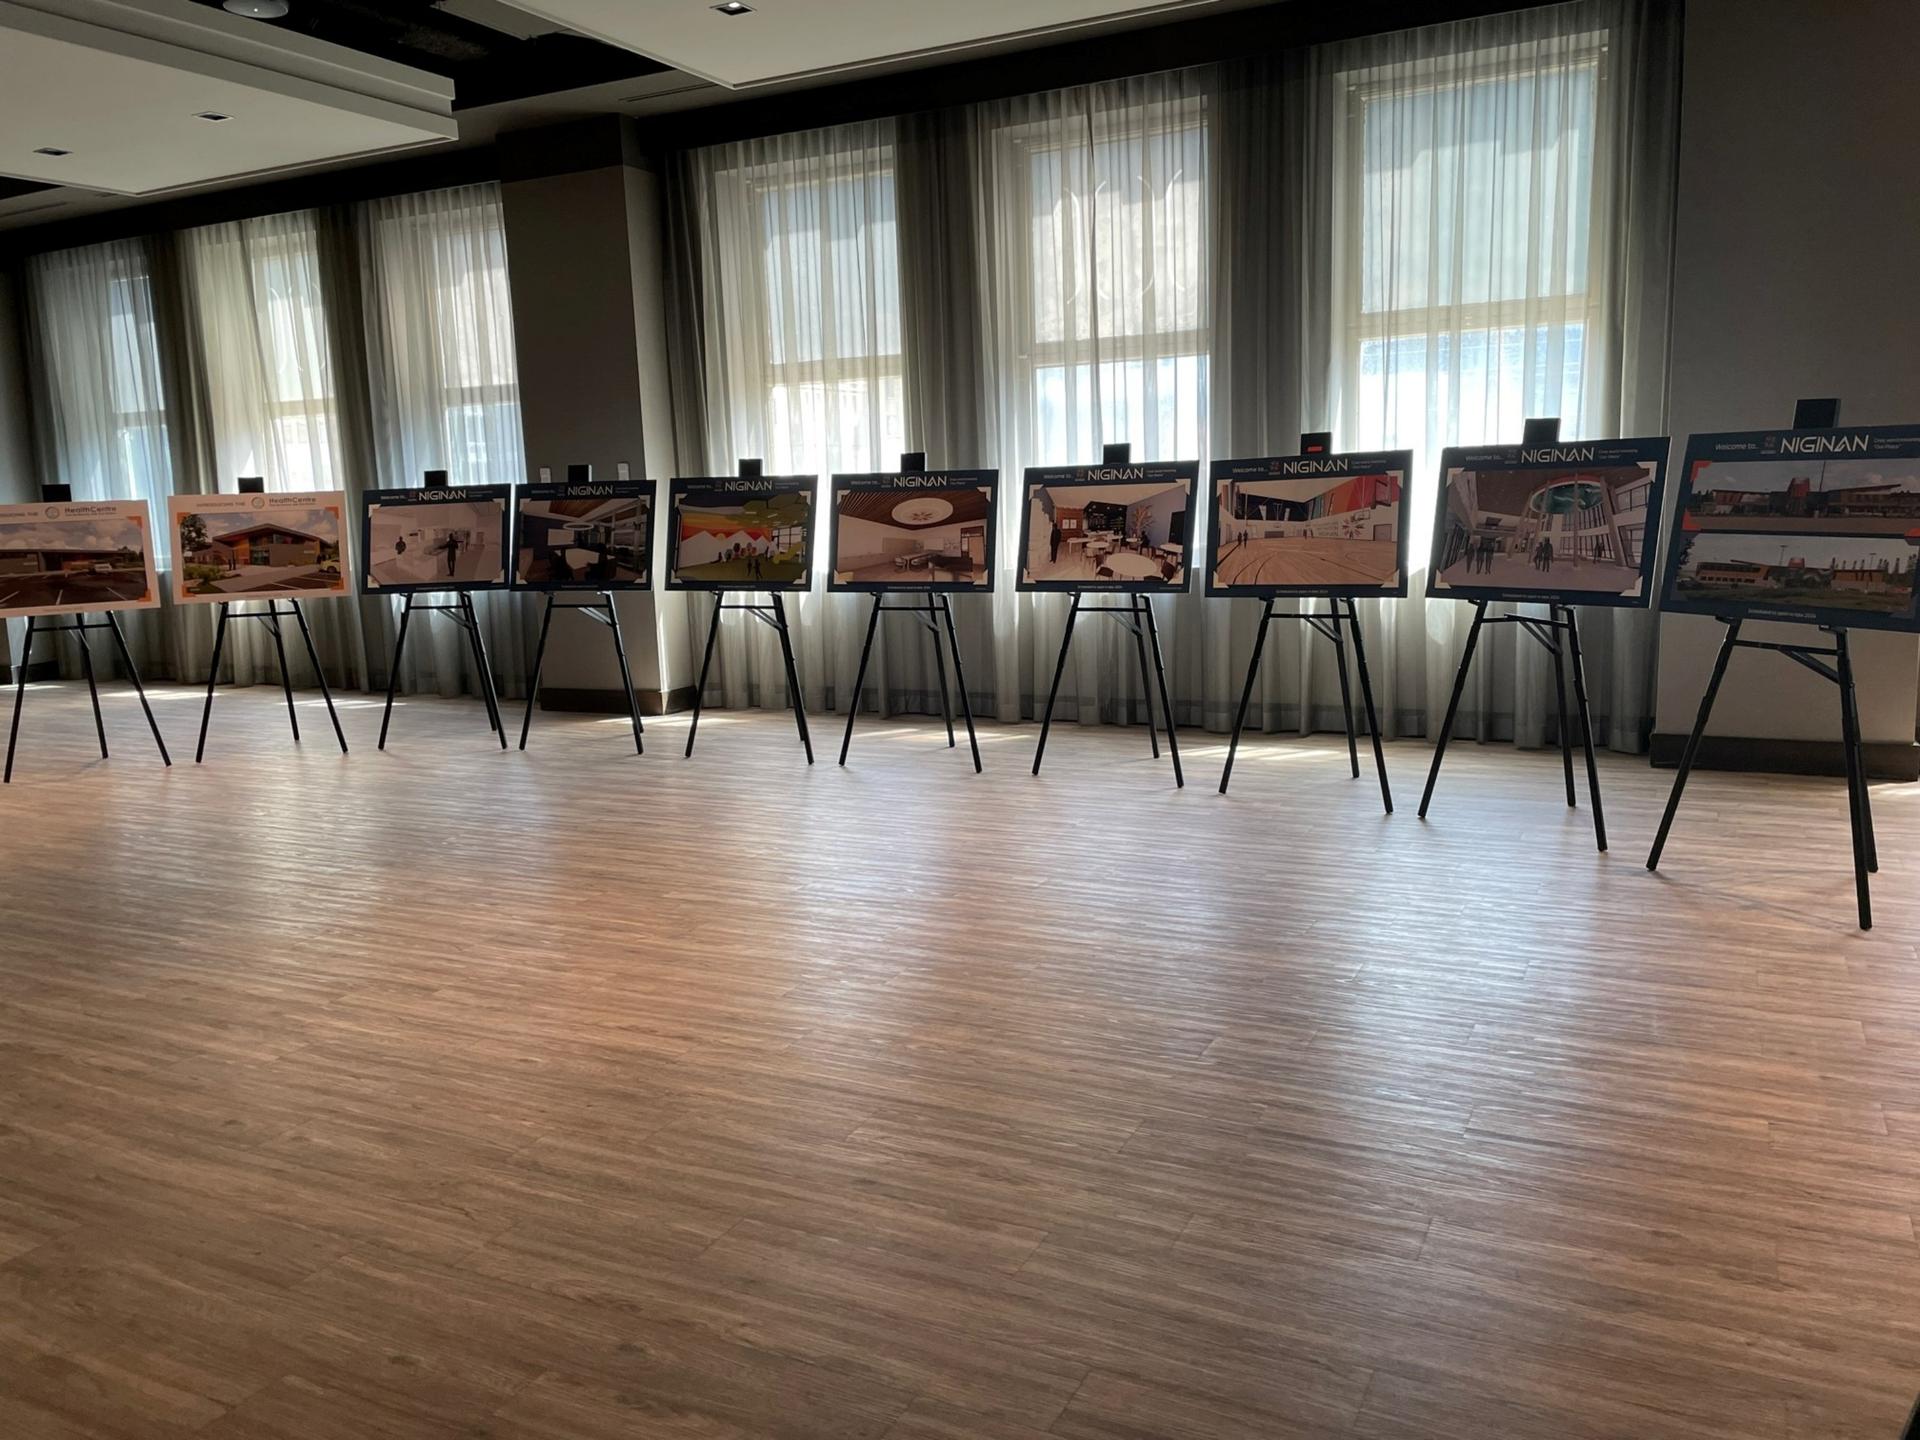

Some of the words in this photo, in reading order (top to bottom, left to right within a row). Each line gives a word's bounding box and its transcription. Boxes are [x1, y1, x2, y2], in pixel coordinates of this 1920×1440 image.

[1780, 434, 1869, 454] NIGINAN
[1521, 447, 1594, 463] NIGINAN
[1283, 458, 1349, 475] NIGINAN
[1087, 467, 1144, 481] NIGINAN
[725, 480, 773, 492] NIGINAN
[893, 476, 947, 488] NIGINAN
[418, 489, 467, 501] NIGINAN
[567, 485, 614, 496] NIGINAN
